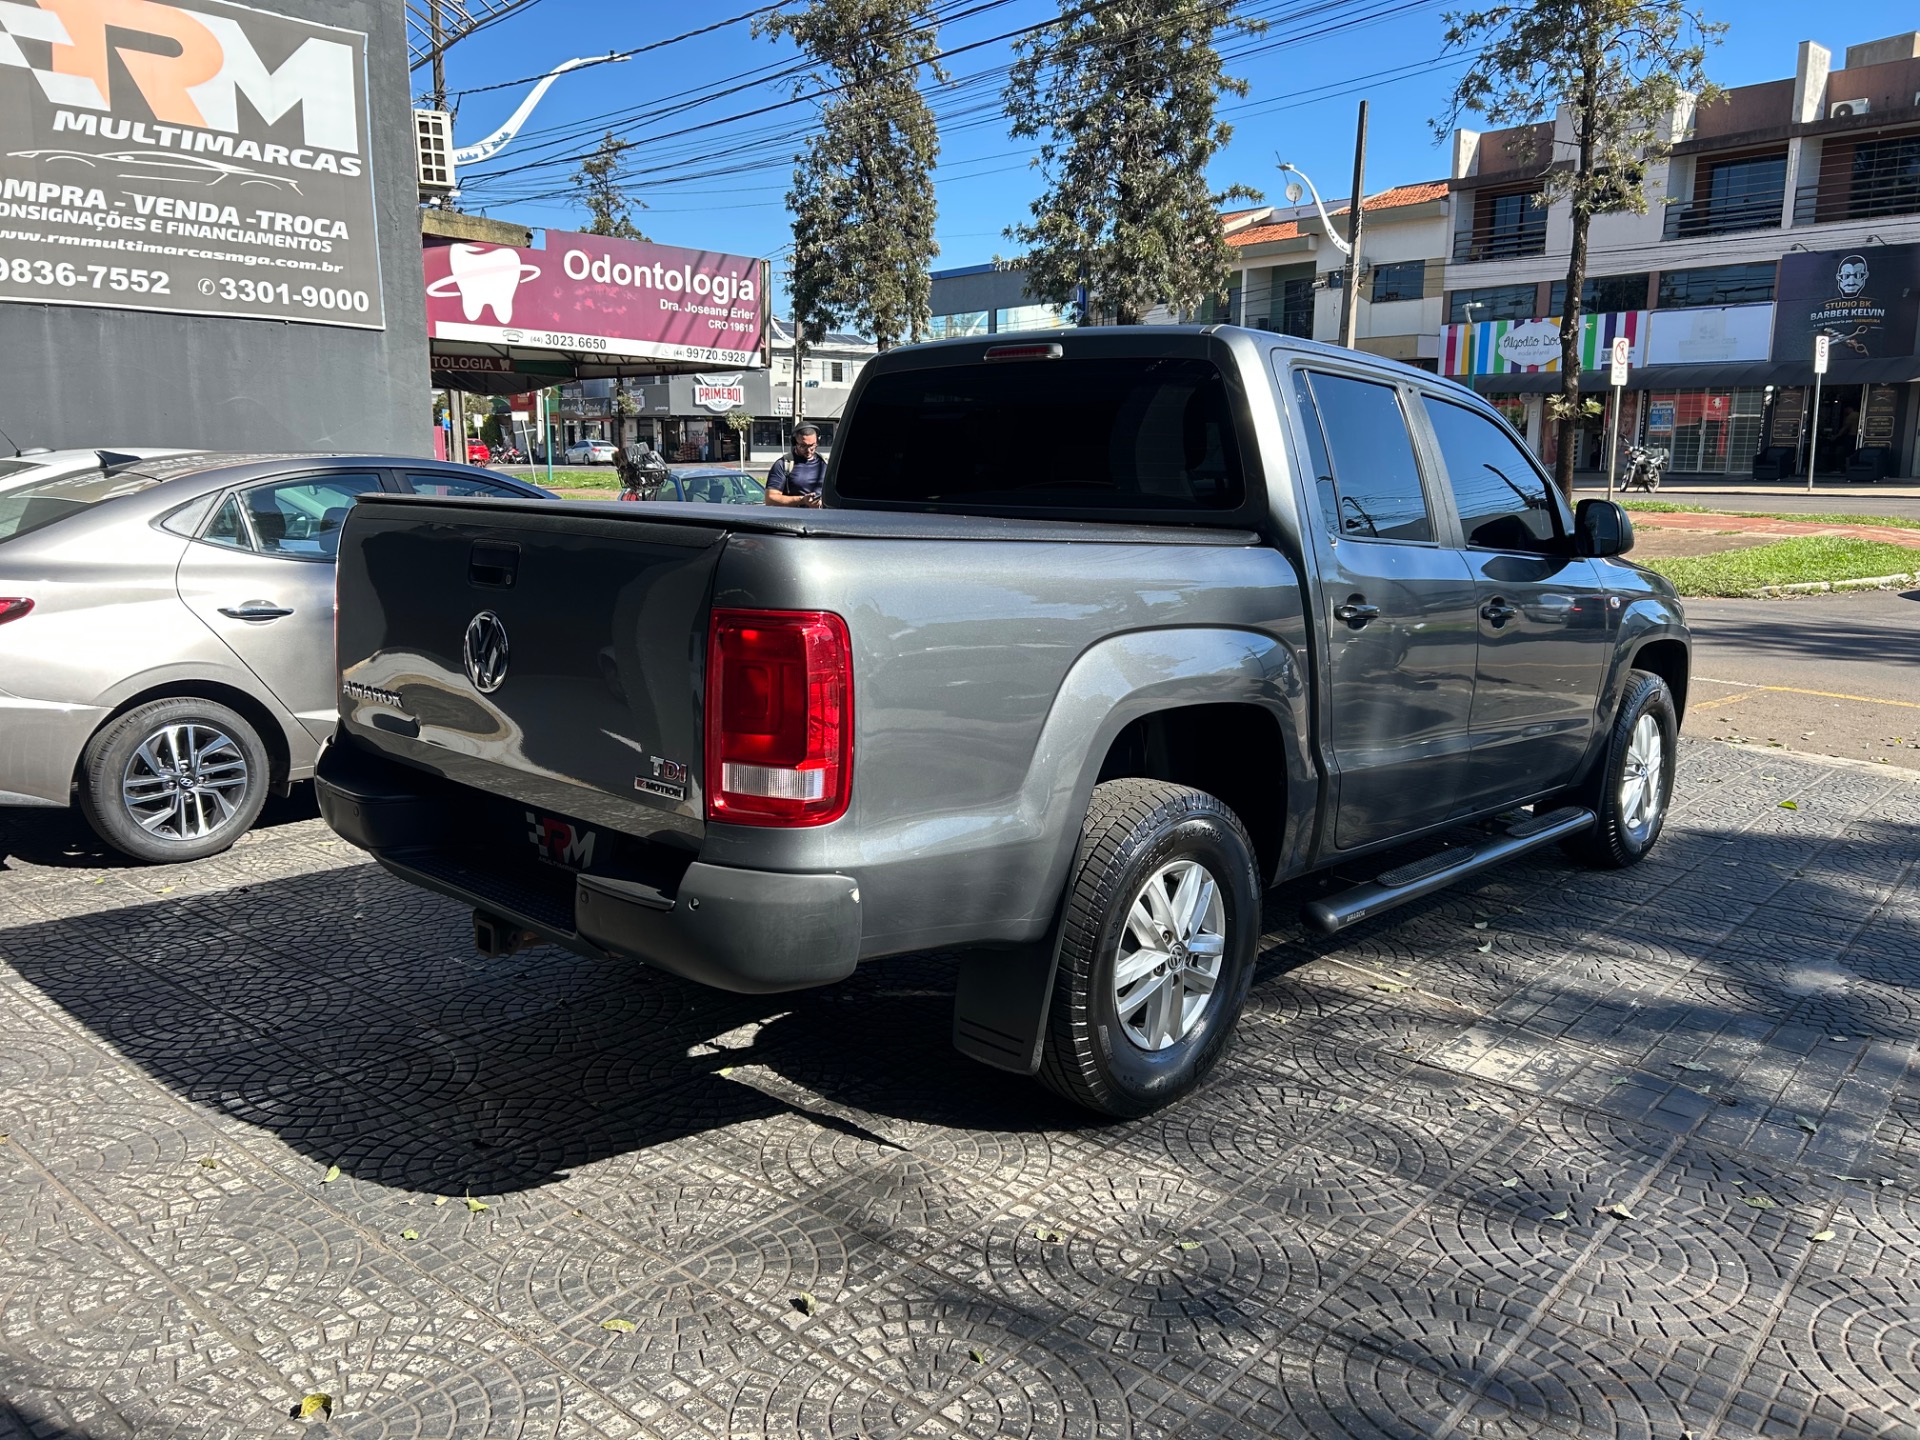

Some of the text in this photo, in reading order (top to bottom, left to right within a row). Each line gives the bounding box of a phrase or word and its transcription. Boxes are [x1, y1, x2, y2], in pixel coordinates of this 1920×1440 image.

[52, 110, 362, 177] MULTIMARCAS
[0, 178, 107, 210] MPRA
[132, 193, 240, 227] VENDA
[150, 220, 162, 233] E
[166, 221, 332, 253] FINANCIAMENTOS
[563, 249, 755, 304] Odontologia
[219, 277, 369, 312] 3301-9000
[660, 298, 755, 320] Dra. Joseane Erler
[1810, 308, 1885, 321] BARBER KELVIN
[1824, 300, 1857, 310] STUDIO
[708, 319, 754, 333] CRO 19618
[530, 333, 607, 350] (44) 3023.6650
[1503, 334, 1561, 350] Algodão Doc
[431, 356, 494, 370] TOLOGIA
[686, 347, 746, 363] 99720.5928
[698, 387, 741, 402] PRIMEBOI
[342, 681, 404, 708] AMAROK
[650, 755, 687, 783] TDI
